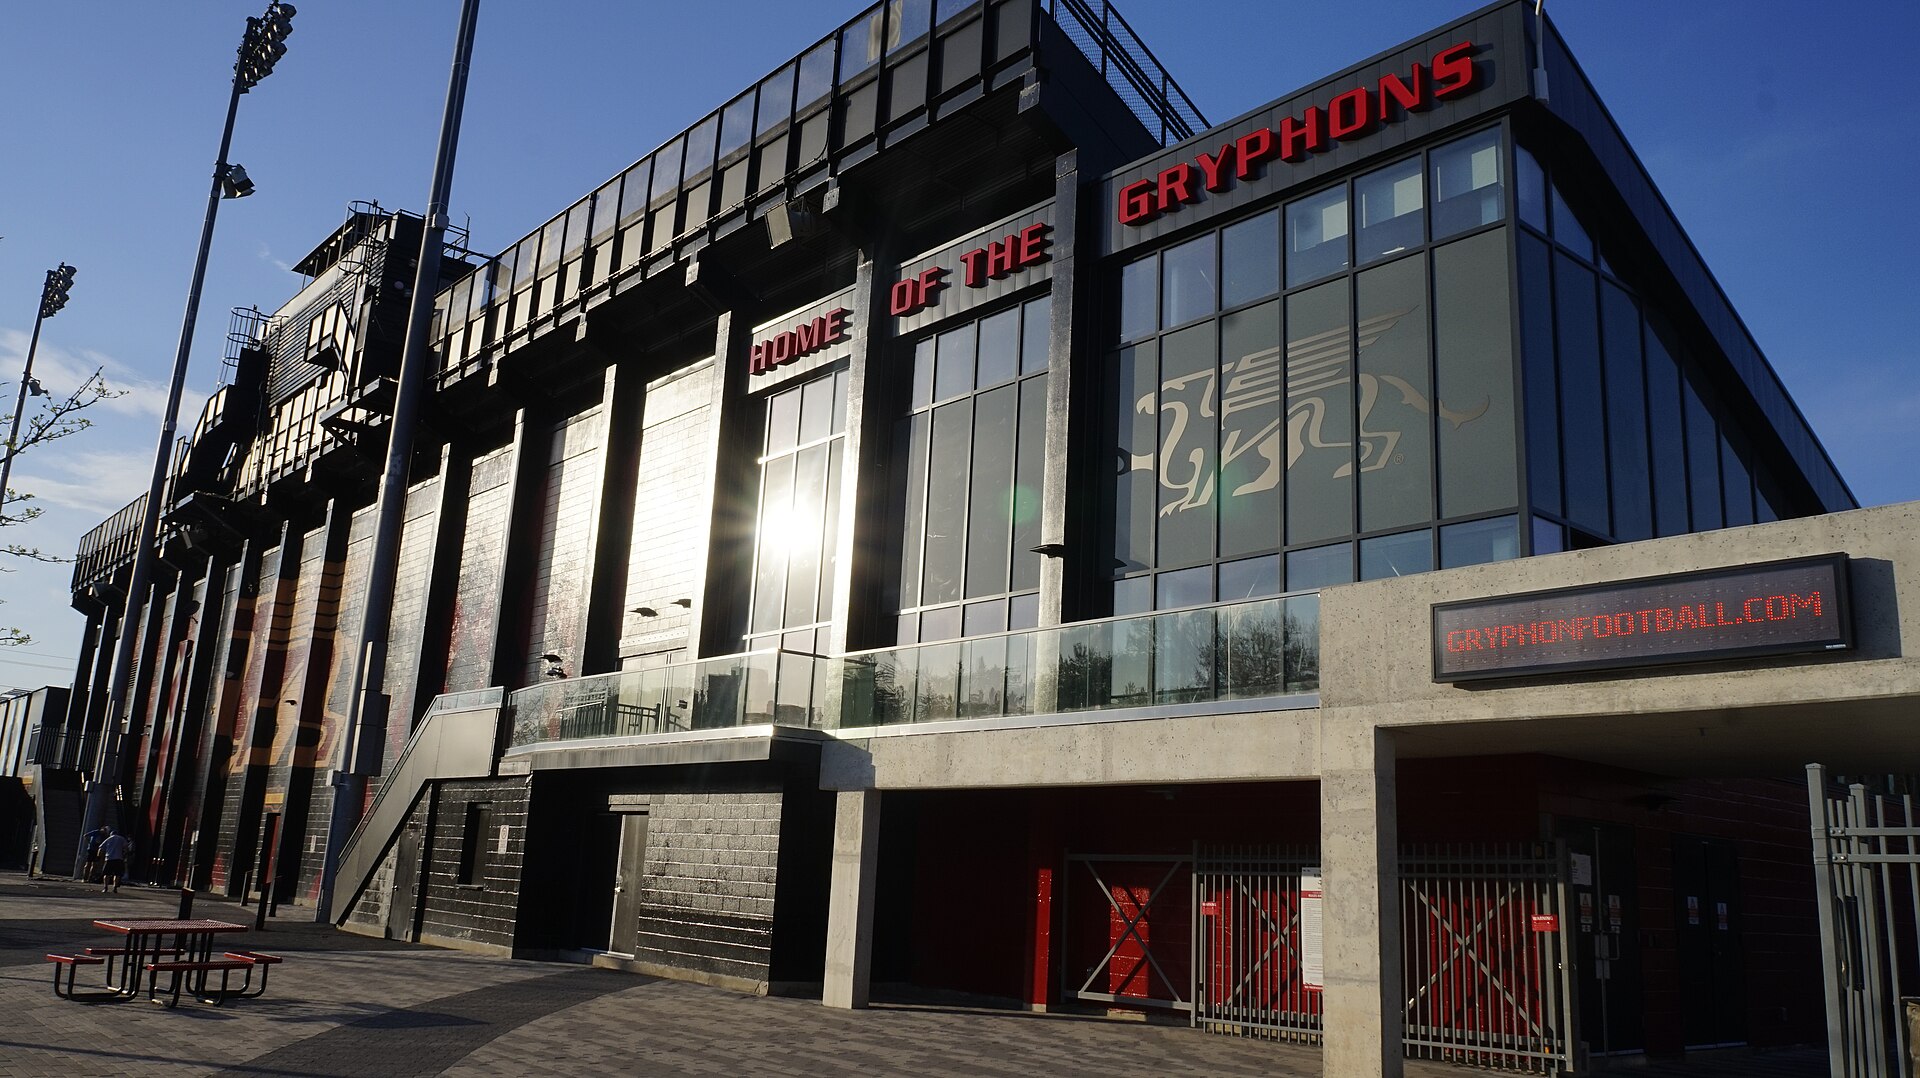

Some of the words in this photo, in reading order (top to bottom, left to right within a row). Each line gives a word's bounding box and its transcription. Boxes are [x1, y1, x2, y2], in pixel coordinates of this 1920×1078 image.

[750, 308, 846, 376] HOME
[891, 266, 945, 316] OF
[960, 222, 1049, 287] THE
[1119, 41, 1476, 226] GRYPHONS
[1448, 591, 1821, 653] GRYPHONFOOTBALL.COM
